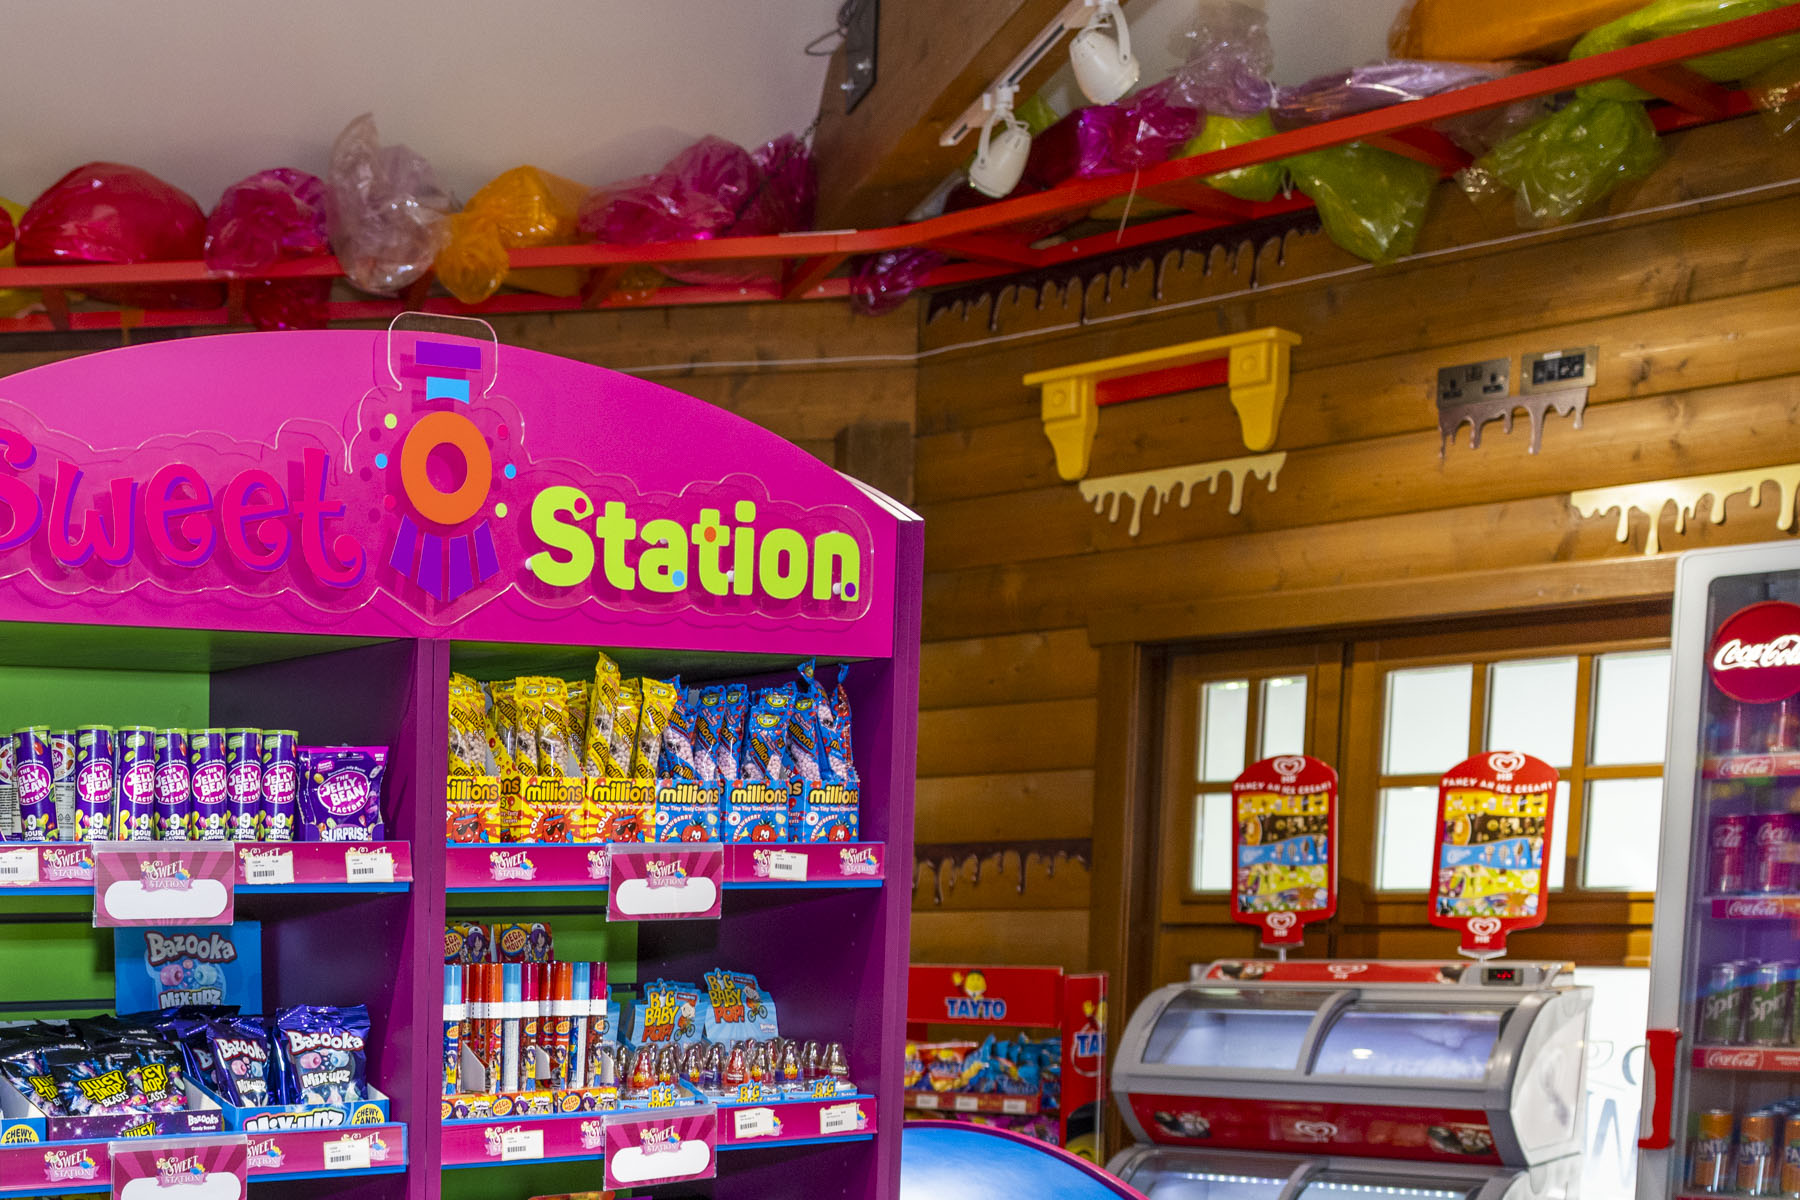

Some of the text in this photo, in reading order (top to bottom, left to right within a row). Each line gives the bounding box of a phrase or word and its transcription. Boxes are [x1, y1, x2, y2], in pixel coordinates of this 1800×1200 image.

[525, 485, 860, 604] Station
[155, 771, 185, 787] JELLY
[323, 777, 358, 798] JELLY
[335, 774, 349, 782] THE
[1442, 778, 1512, 793] FANCY AN ICE
[160, 779, 189, 797] BEAN
[330, 787, 366, 807] BEAN
[526, 780, 583, 803] millions
[592, 781, 655, 803] millions
[658, 783, 719, 805] millions
[731, 783, 788, 804] millions
[809, 783, 858, 805] millions
[332, 799, 366, 814] FACTORY
[170, 813, 180, 829] 9
[209, 813, 219, 829] 9
[529, 811, 544, 834] COLA
[596, 811, 613, 834] COLA
[321, 827, 369, 841] SURPRISE
[147, 932, 235, 963] Bazooka
[503, 931, 523, 945] MEGA
[708, 988, 743, 1007] BABY
[645, 1006, 679, 1026] BABY
[714, 1005, 745, 1023] POP!
[945, 998, 1006, 1020] TAYTO
[288, 1031, 364, 1054] Bazooka
[642, 1024, 674, 1042] POP!
[216, 1039, 267, 1061] Bazooka
[81, 1071, 124, 1093] JUICY
[94, 1081, 124, 1100] DROP
[102, 1091, 130, 1107] BLASTS
[356, 1110, 379, 1118] CHEWY
[5, 1128, 33, 1142] CHEWY
